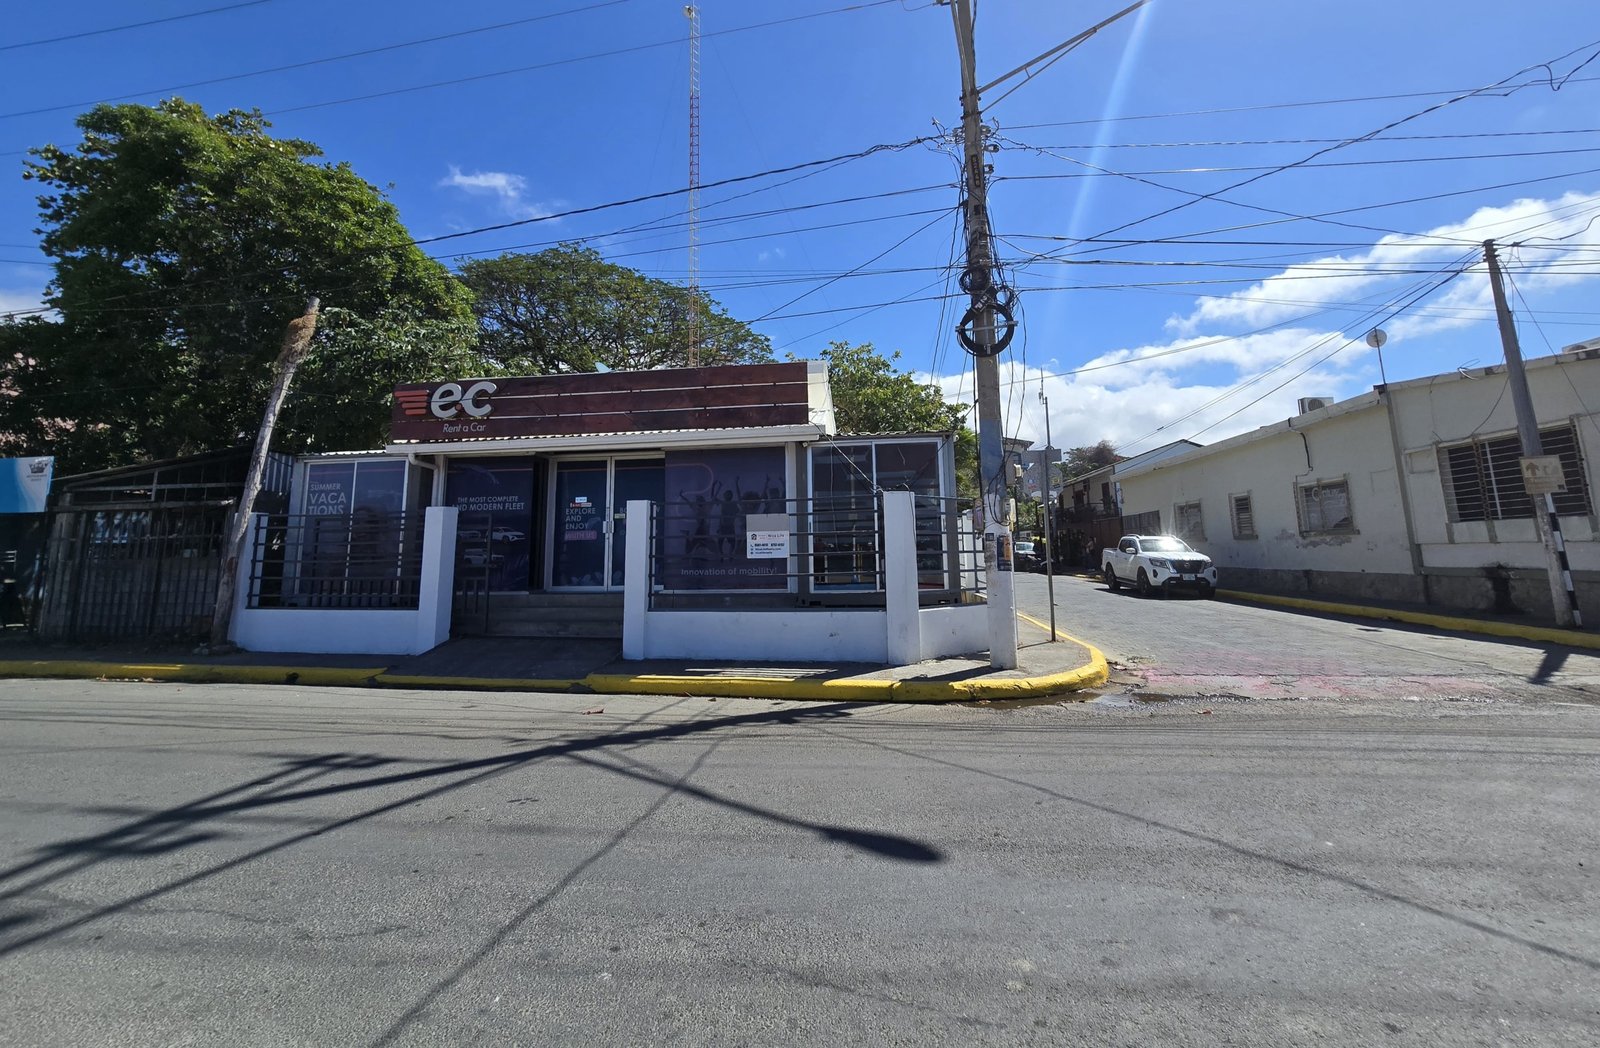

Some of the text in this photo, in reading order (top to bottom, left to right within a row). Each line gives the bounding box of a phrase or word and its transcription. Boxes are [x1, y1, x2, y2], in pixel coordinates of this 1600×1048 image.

[443, 424, 460, 433] Rent
[471, 423, 486, 432] Car
[310, 483, 341, 491] SUMMER
[310, 492, 346, 504] VACA
[308, 505, 344, 515] TIONS
[469, 503, 503, 511] MODERN
[505, 502, 525, 510] FLEET
[565, 507, 596, 515] EXPLORE
[681, 567, 777, 576] Innovation of mobility!
